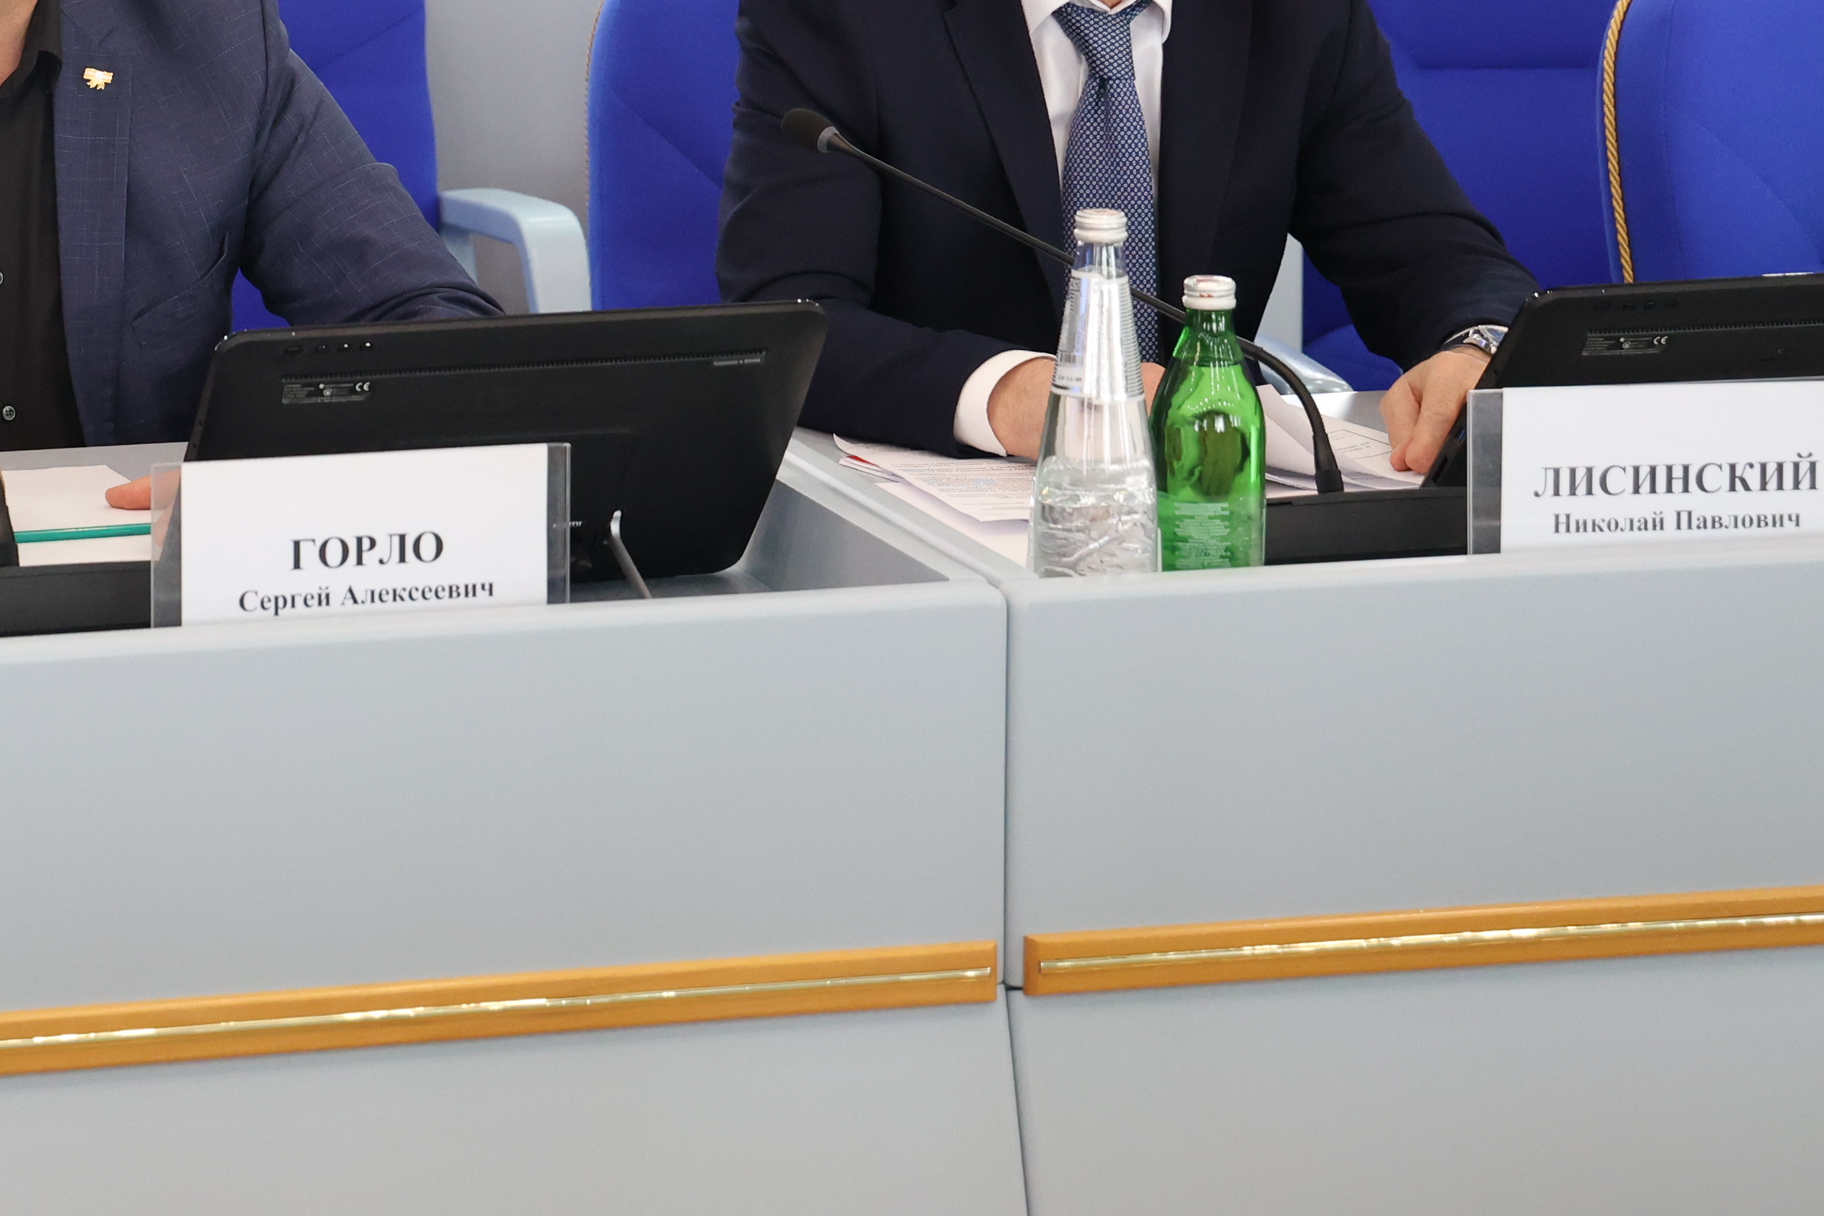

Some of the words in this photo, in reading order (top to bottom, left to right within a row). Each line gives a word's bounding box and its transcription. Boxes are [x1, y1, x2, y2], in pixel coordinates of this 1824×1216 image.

[1533, 452, 1819, 498] ЛИСИНСКИЙ
[1553, 510, 1665, 534] Николай
[1675, 509, 1801, 533] Павлович
[290, 531, 444, 571] ГОРЛО
[238, 587, 332, 616] Сергей
[340, 581, 495, 607] Алексеевич
